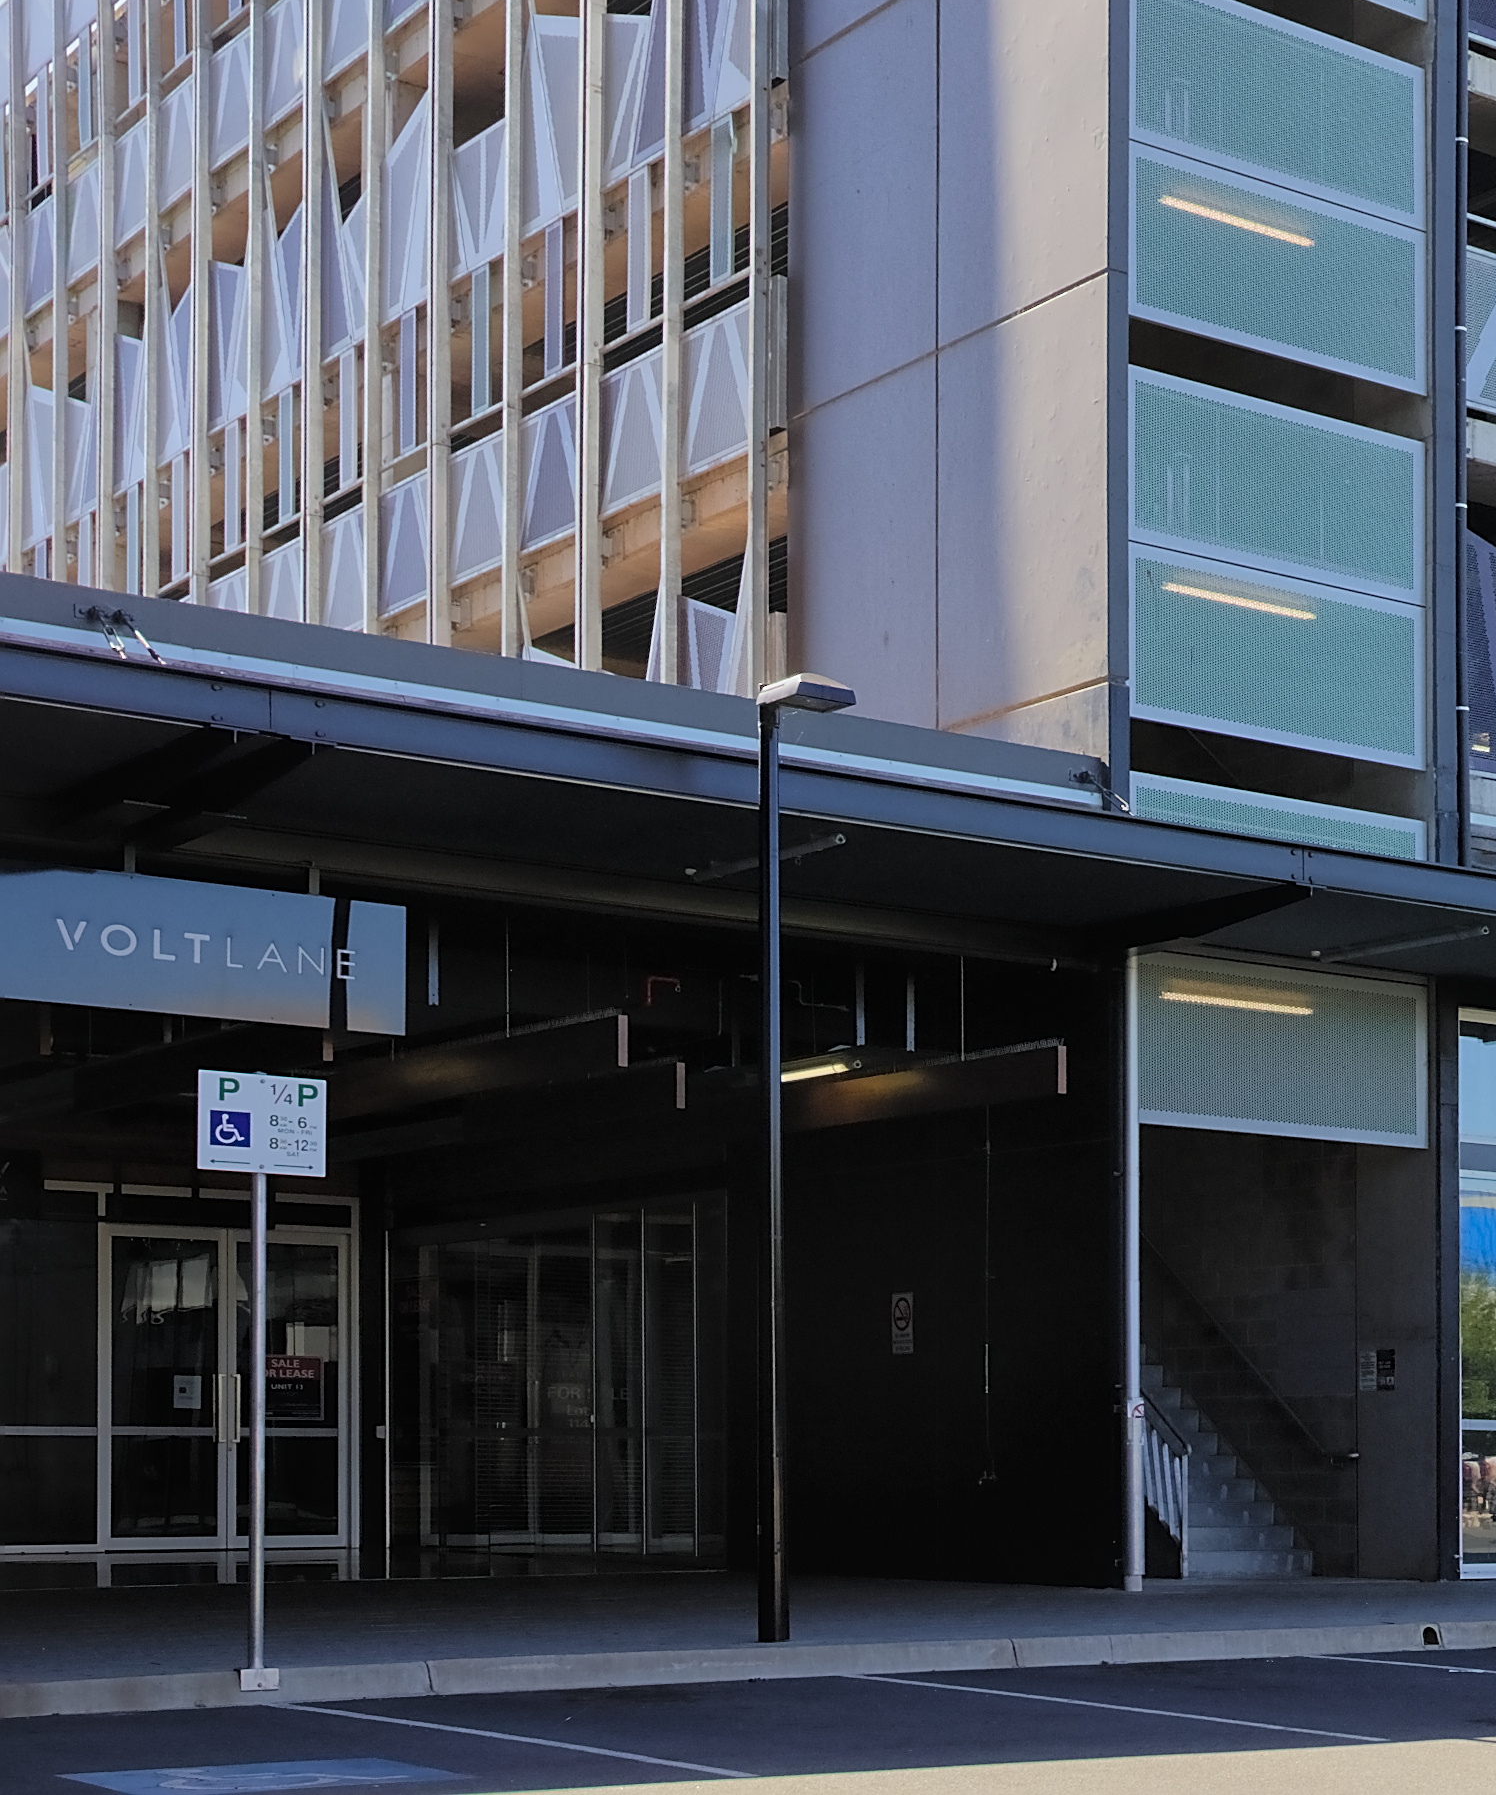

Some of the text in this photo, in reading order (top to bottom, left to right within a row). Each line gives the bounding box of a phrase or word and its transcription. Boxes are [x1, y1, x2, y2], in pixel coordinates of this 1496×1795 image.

[56, 918, 356, 980] VOLTLANE
[219, 1077, 240, 1101] P
[298, 1084, 318, 1107] P
[271, 1358, 300, 1368] SALE
[280, 1369, 315, 1378] LEASE
[547, 1386, 581, 1400] FOR
